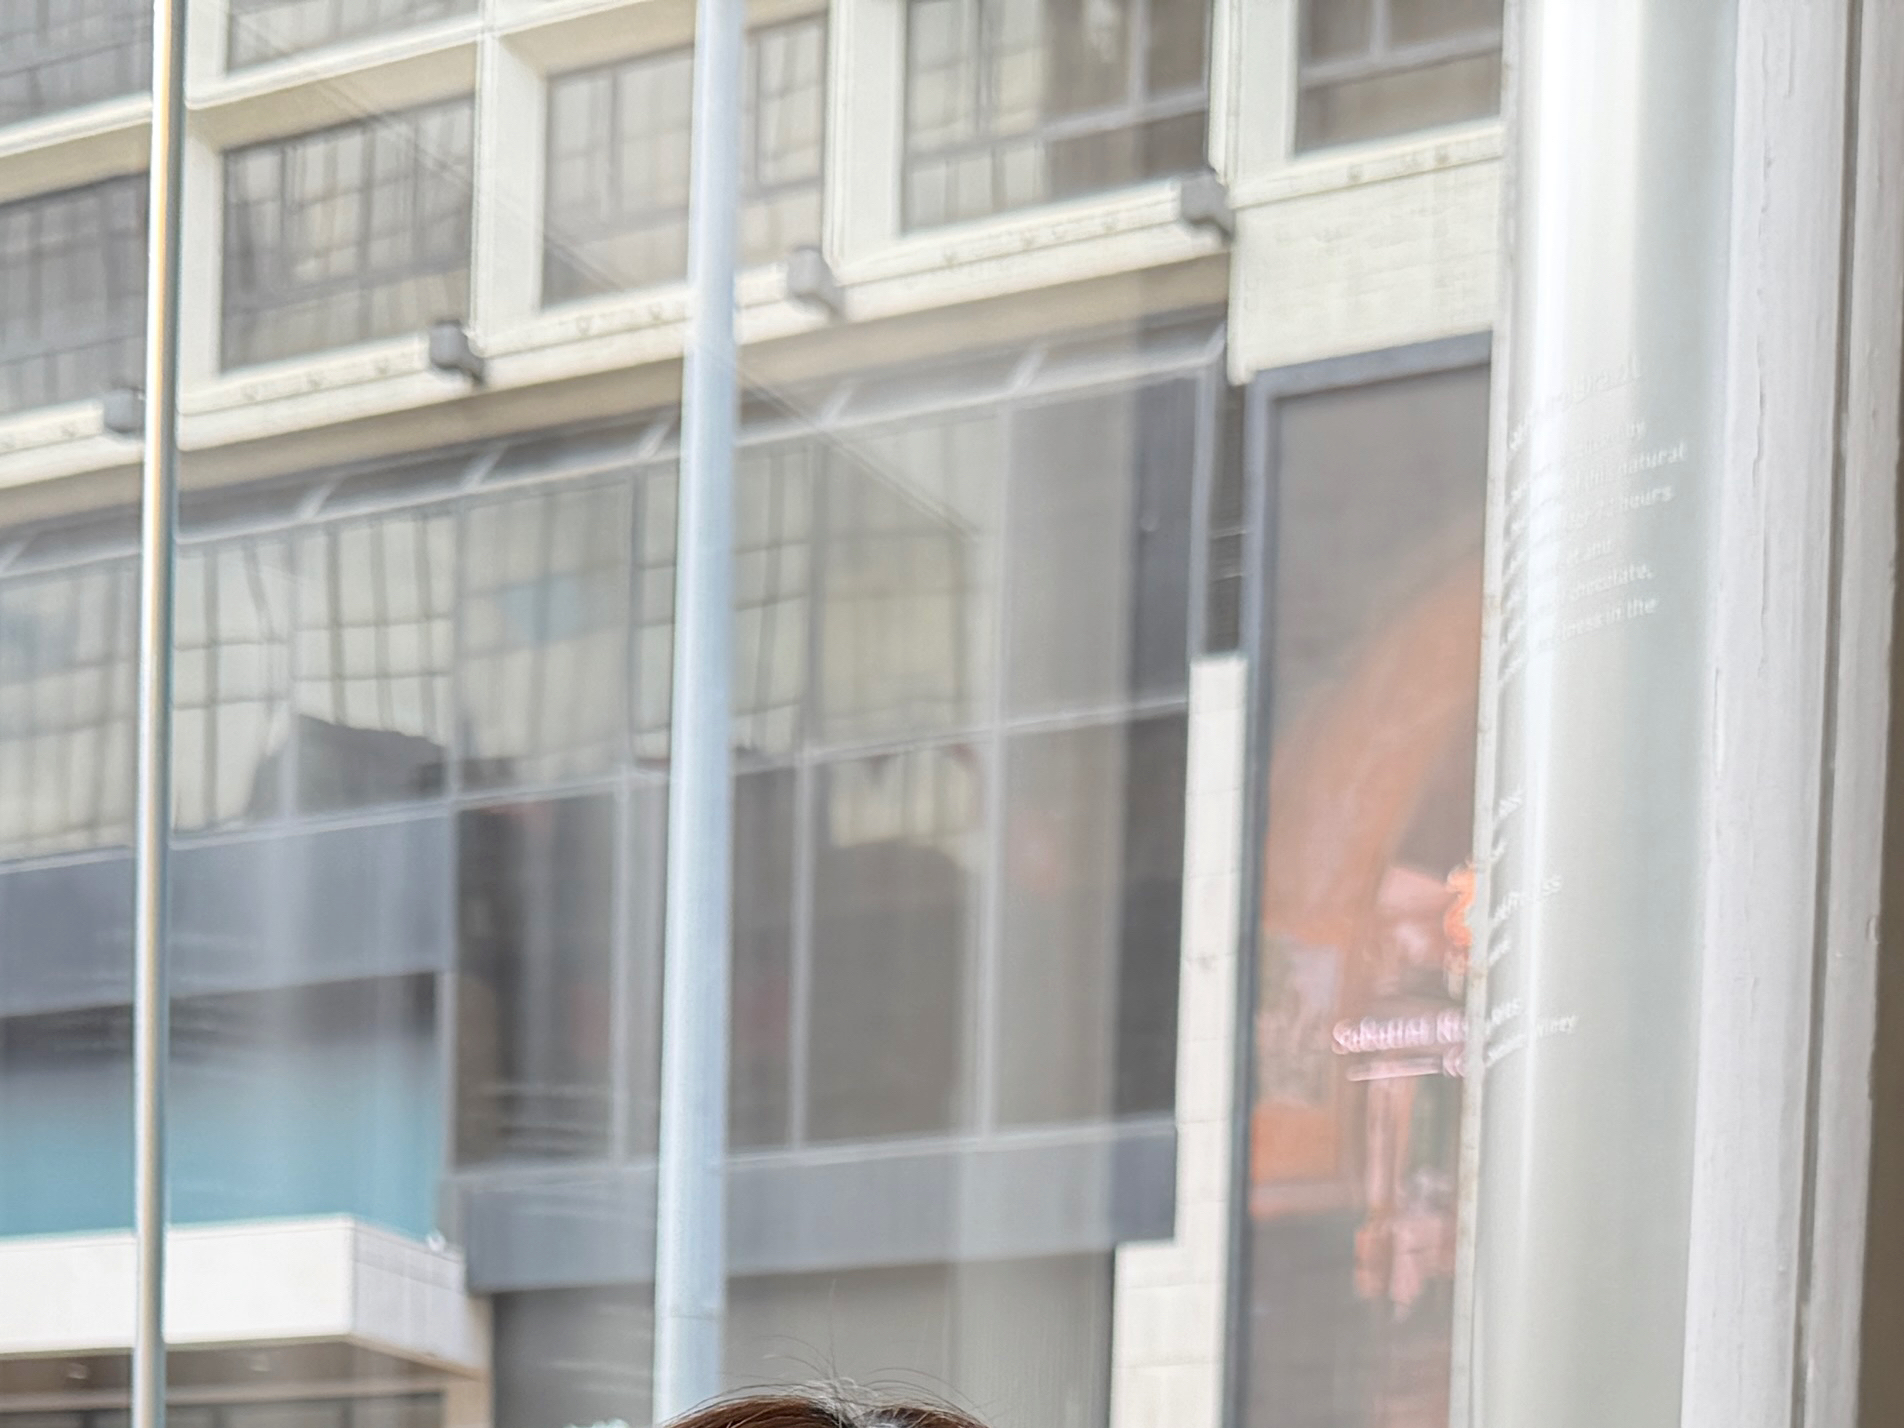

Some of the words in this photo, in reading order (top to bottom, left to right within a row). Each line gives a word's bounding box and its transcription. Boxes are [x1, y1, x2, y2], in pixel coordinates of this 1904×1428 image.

[1618, 439, 1687, 476] natural
[1620, 484, 1675, 513] hours
[1627, 597, 1659, 621] the
